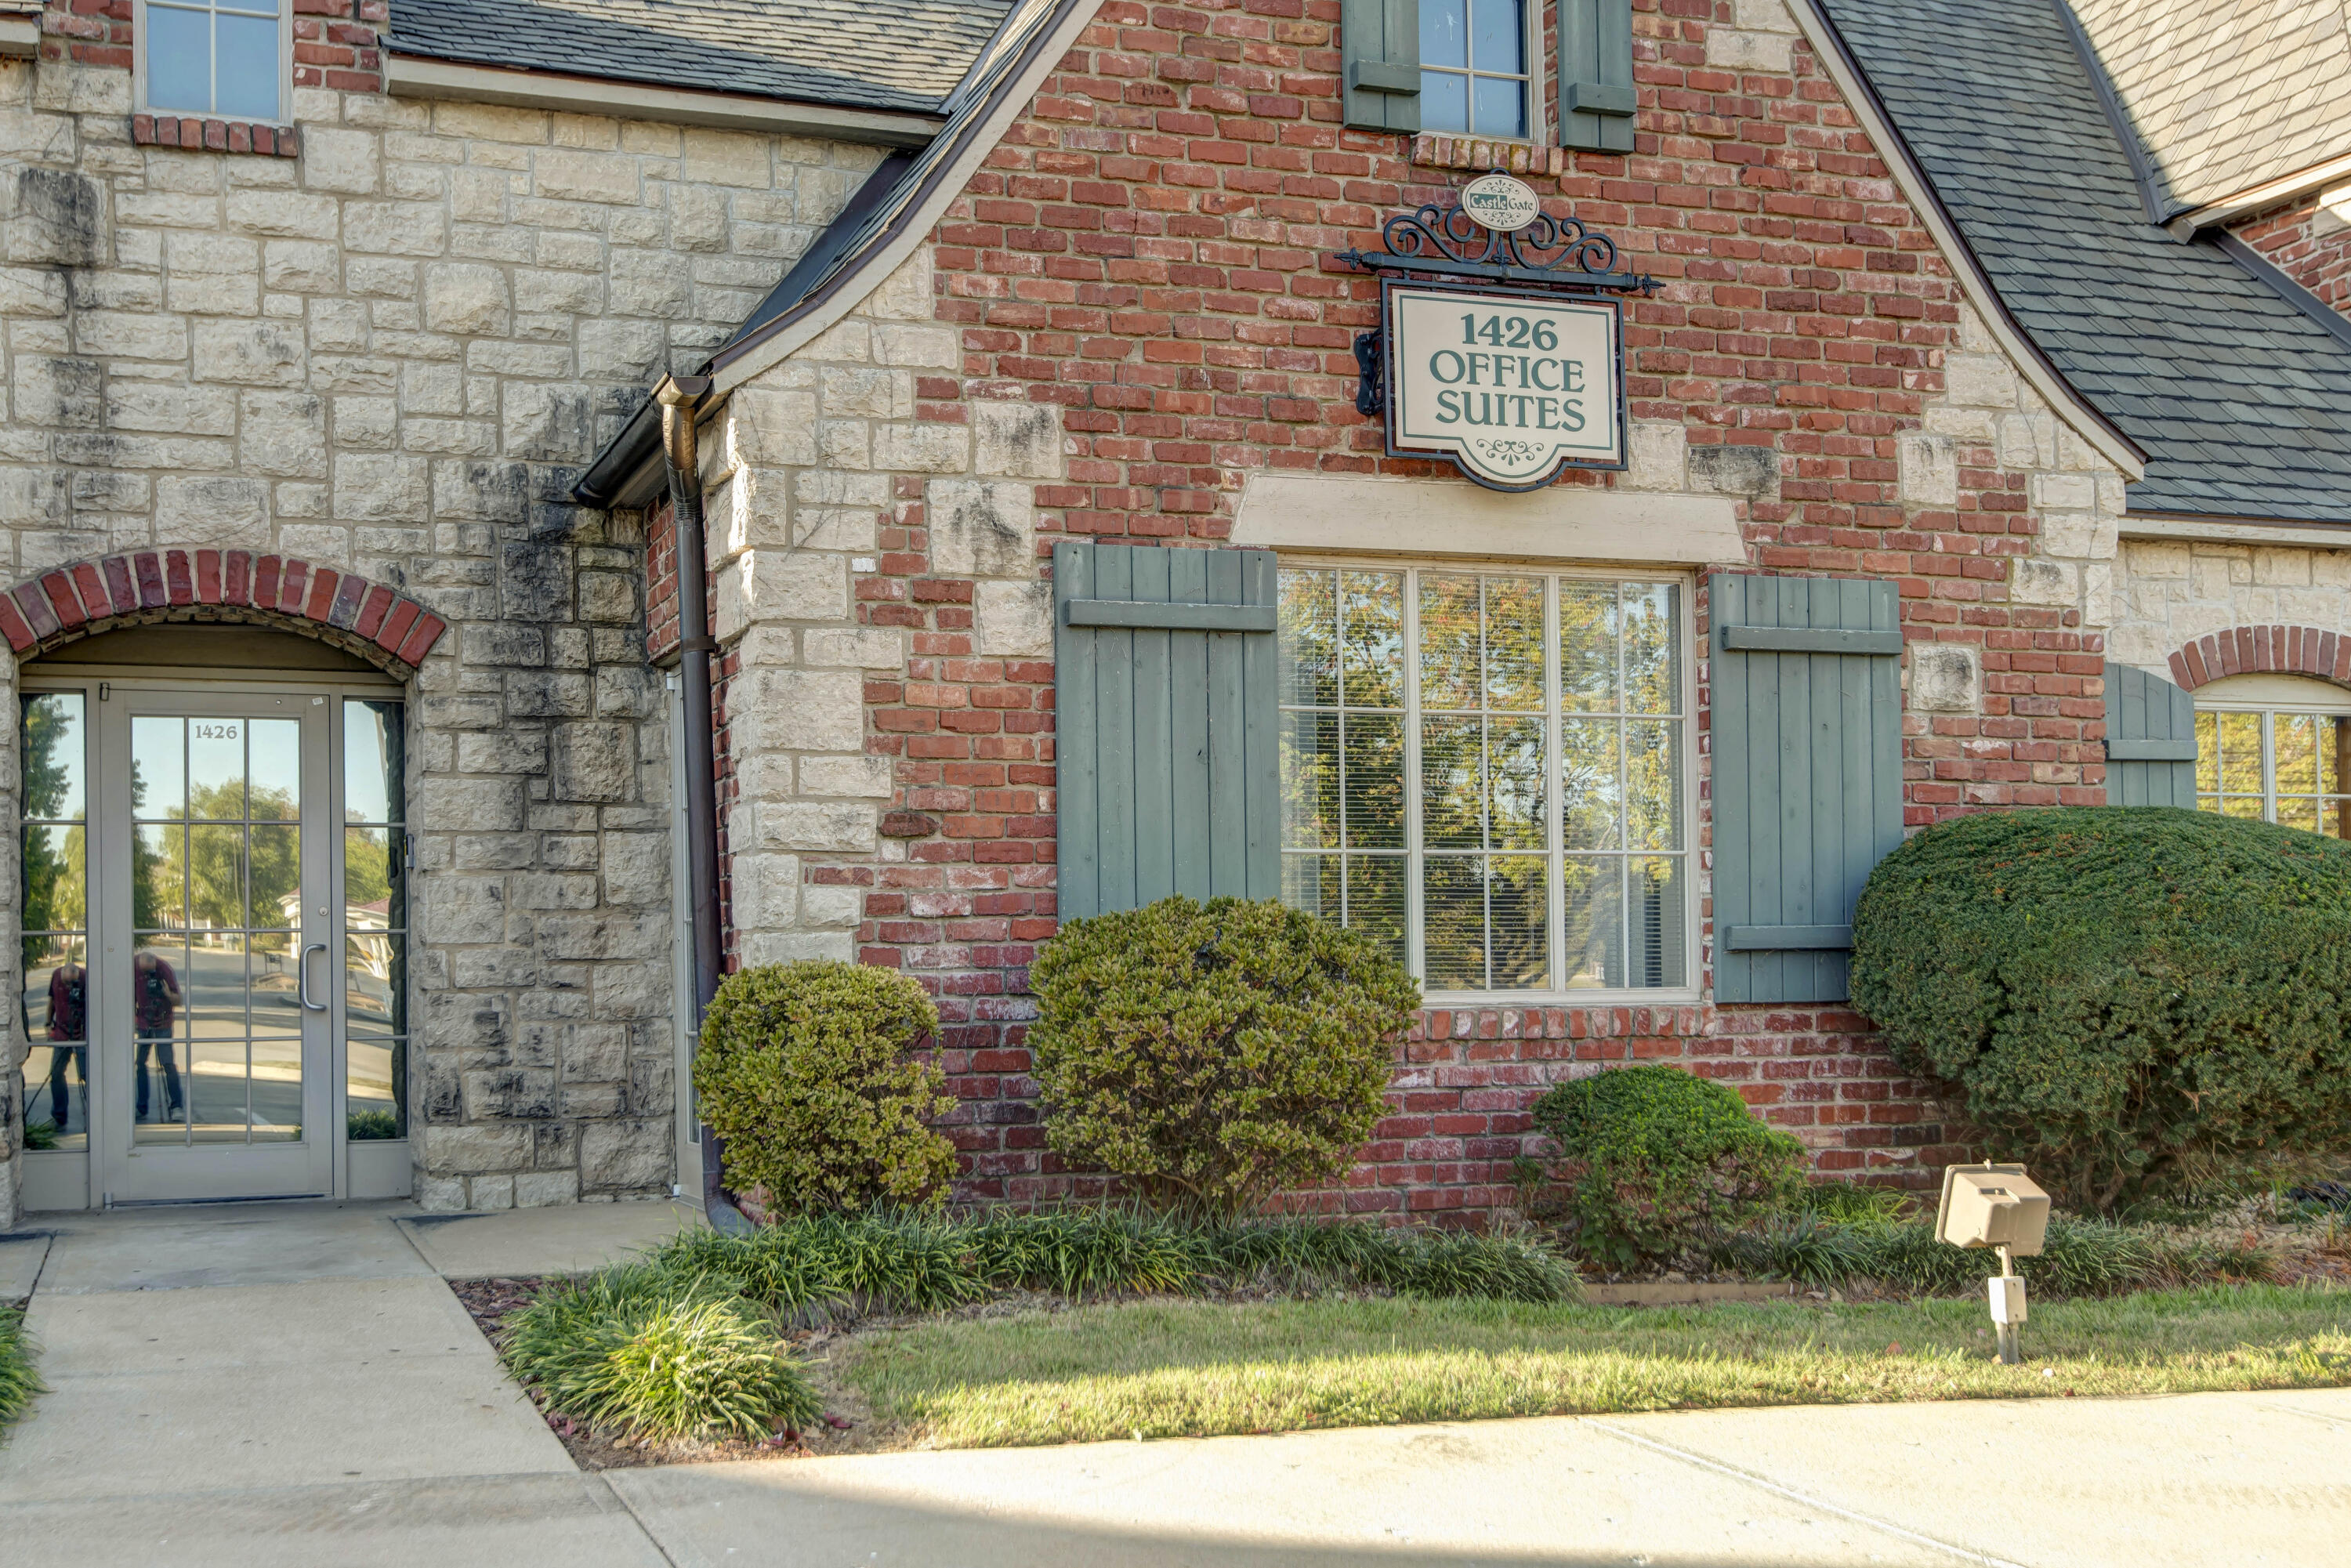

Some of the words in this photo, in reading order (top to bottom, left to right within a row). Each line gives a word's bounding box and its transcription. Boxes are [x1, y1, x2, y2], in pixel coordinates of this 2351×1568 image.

[1461, 313, 1559, 351] 1426
[1429, 349, 1585, 393] OFFICE
[1436, 389, 1586, 432] SUITES
[195, 725, 237, 739] 1426
